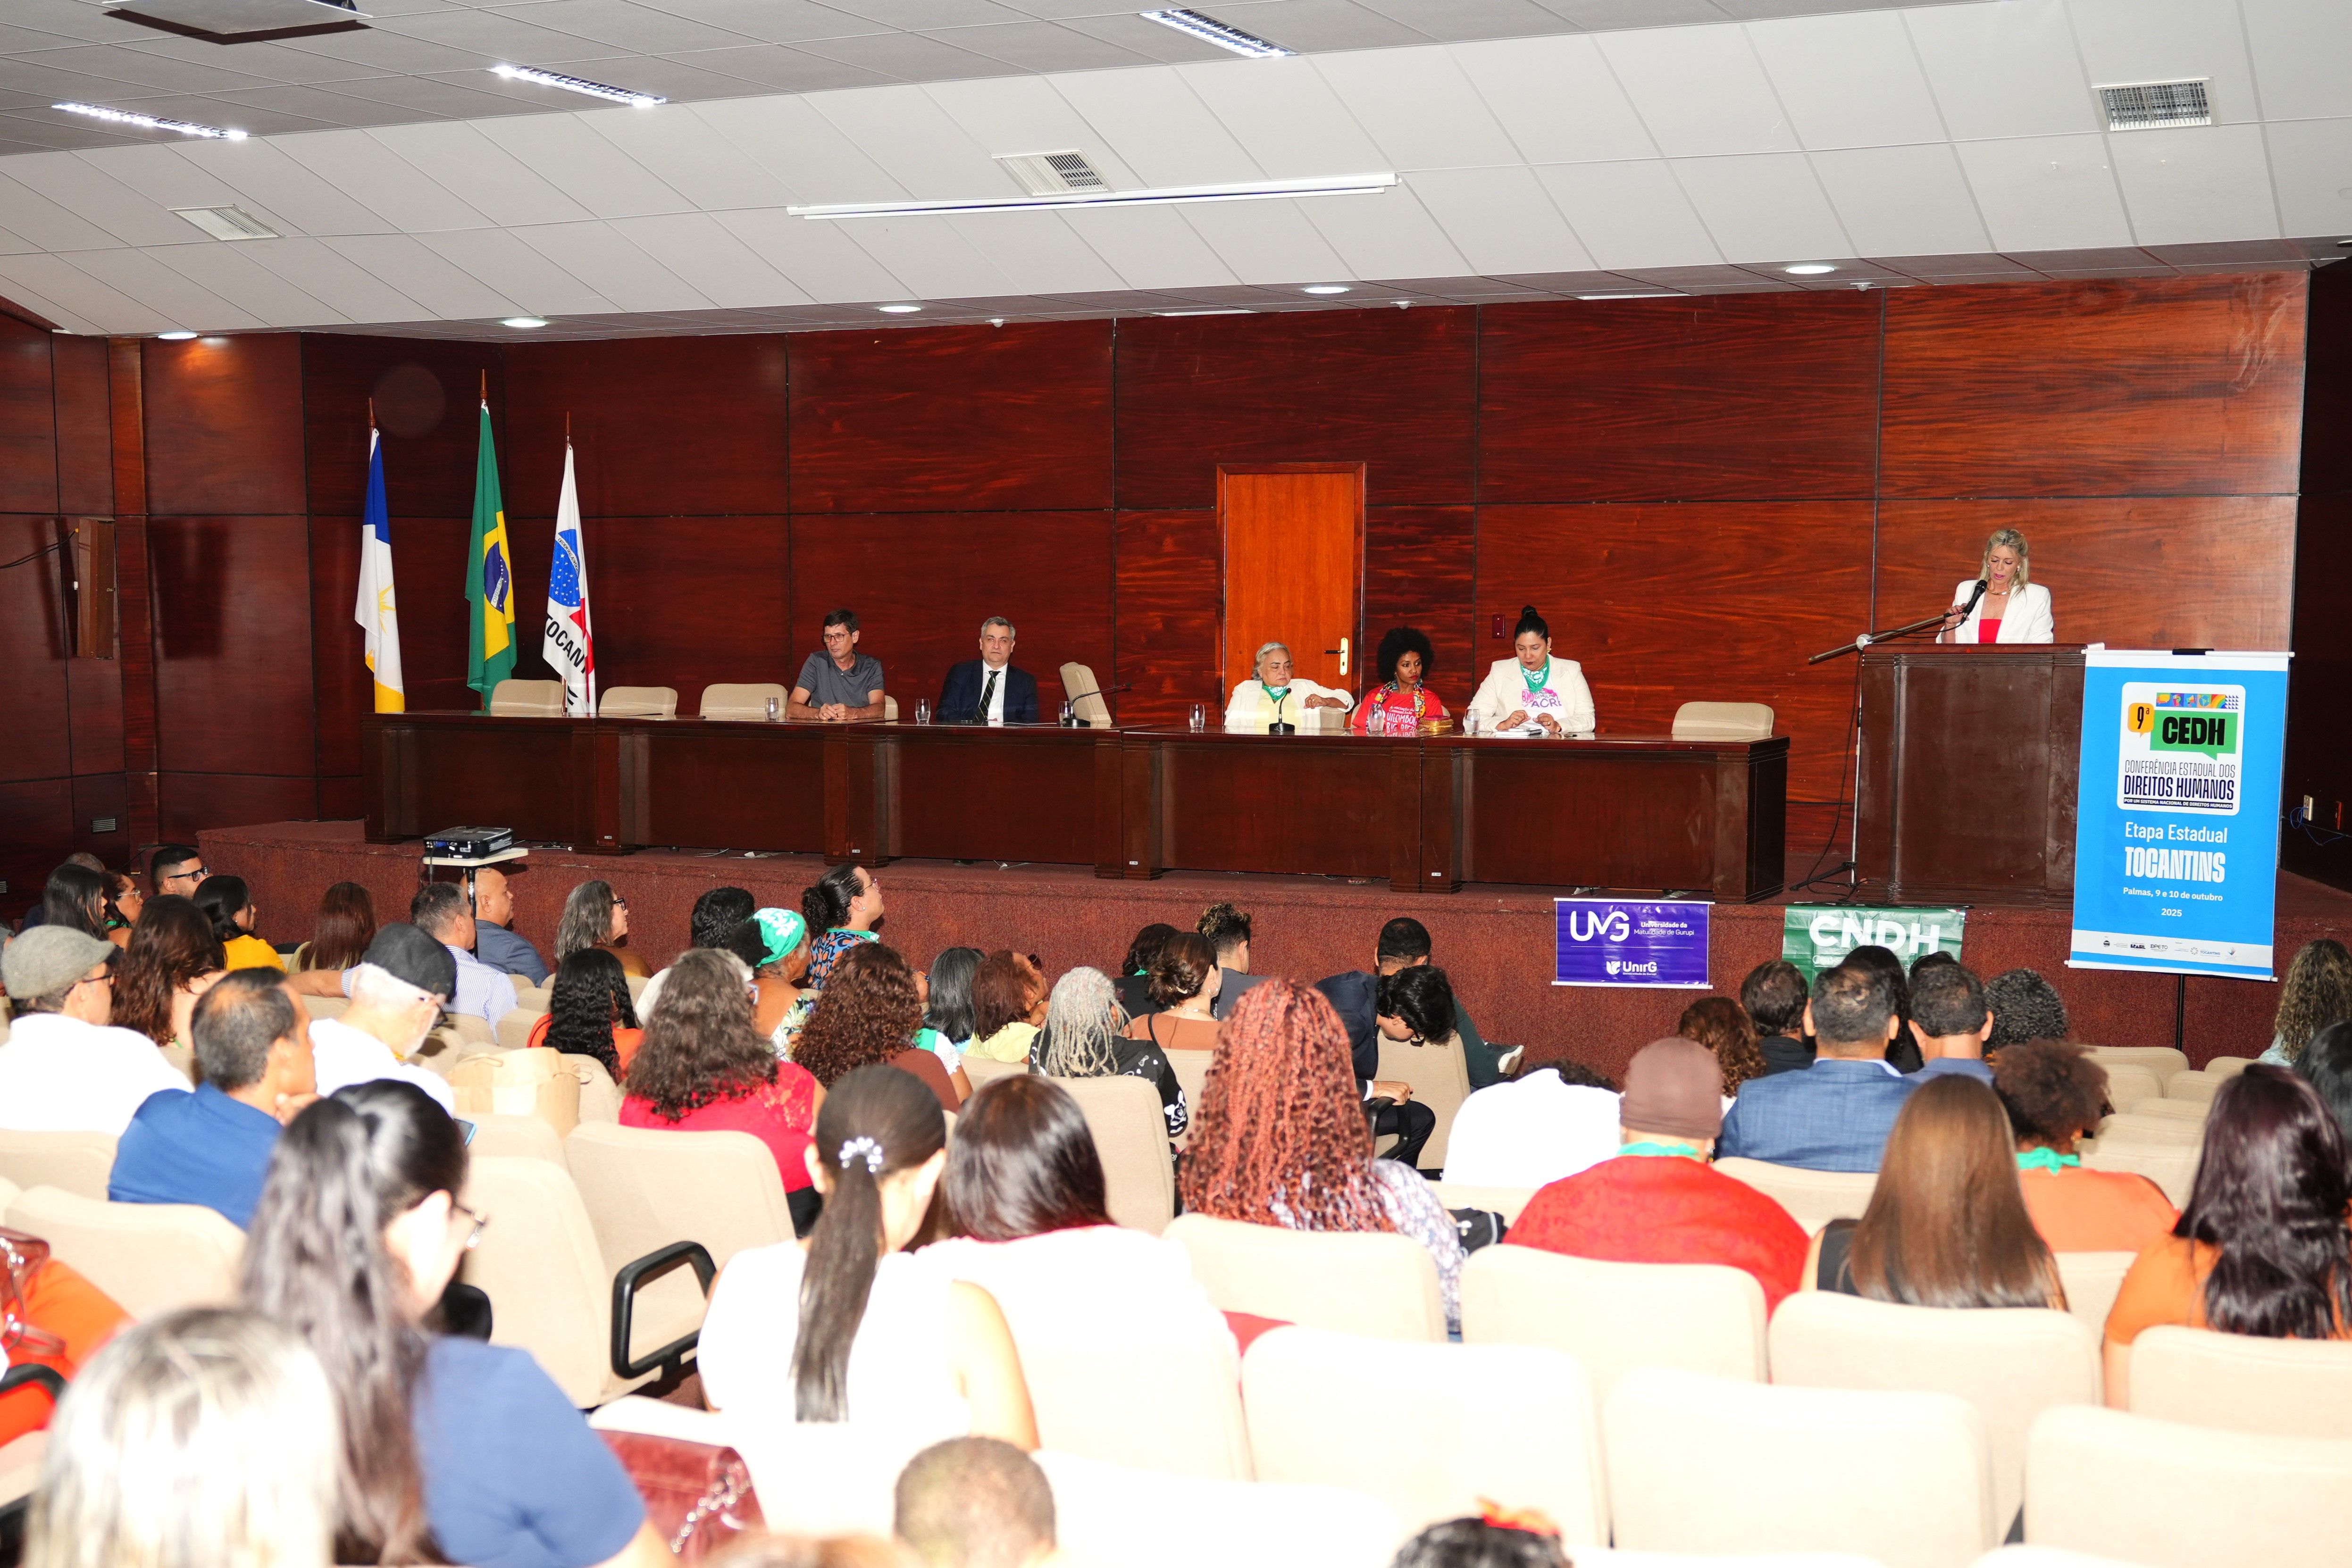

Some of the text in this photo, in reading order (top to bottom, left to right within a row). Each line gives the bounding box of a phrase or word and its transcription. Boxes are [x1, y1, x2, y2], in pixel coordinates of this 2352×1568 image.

[2162, 717, 2226, 746] CEDH
[2125, 759, 2235, 778] CONFERÊNCIA ESTADUAL DOS
[2124, 775, 2235, 801] DIREITOS HUMANOS
[2125, 822, 2227, 843] Etapa Estadual
[2125, 846, 2226, 883] TOCANTINS
[2123, 887, 2153, 897] Palmas,
[2161, 908, 2182, 917] 2025
[1809, 915, 1941, 954] CNDH
[1623, 961, 1657, 973] UnirG
